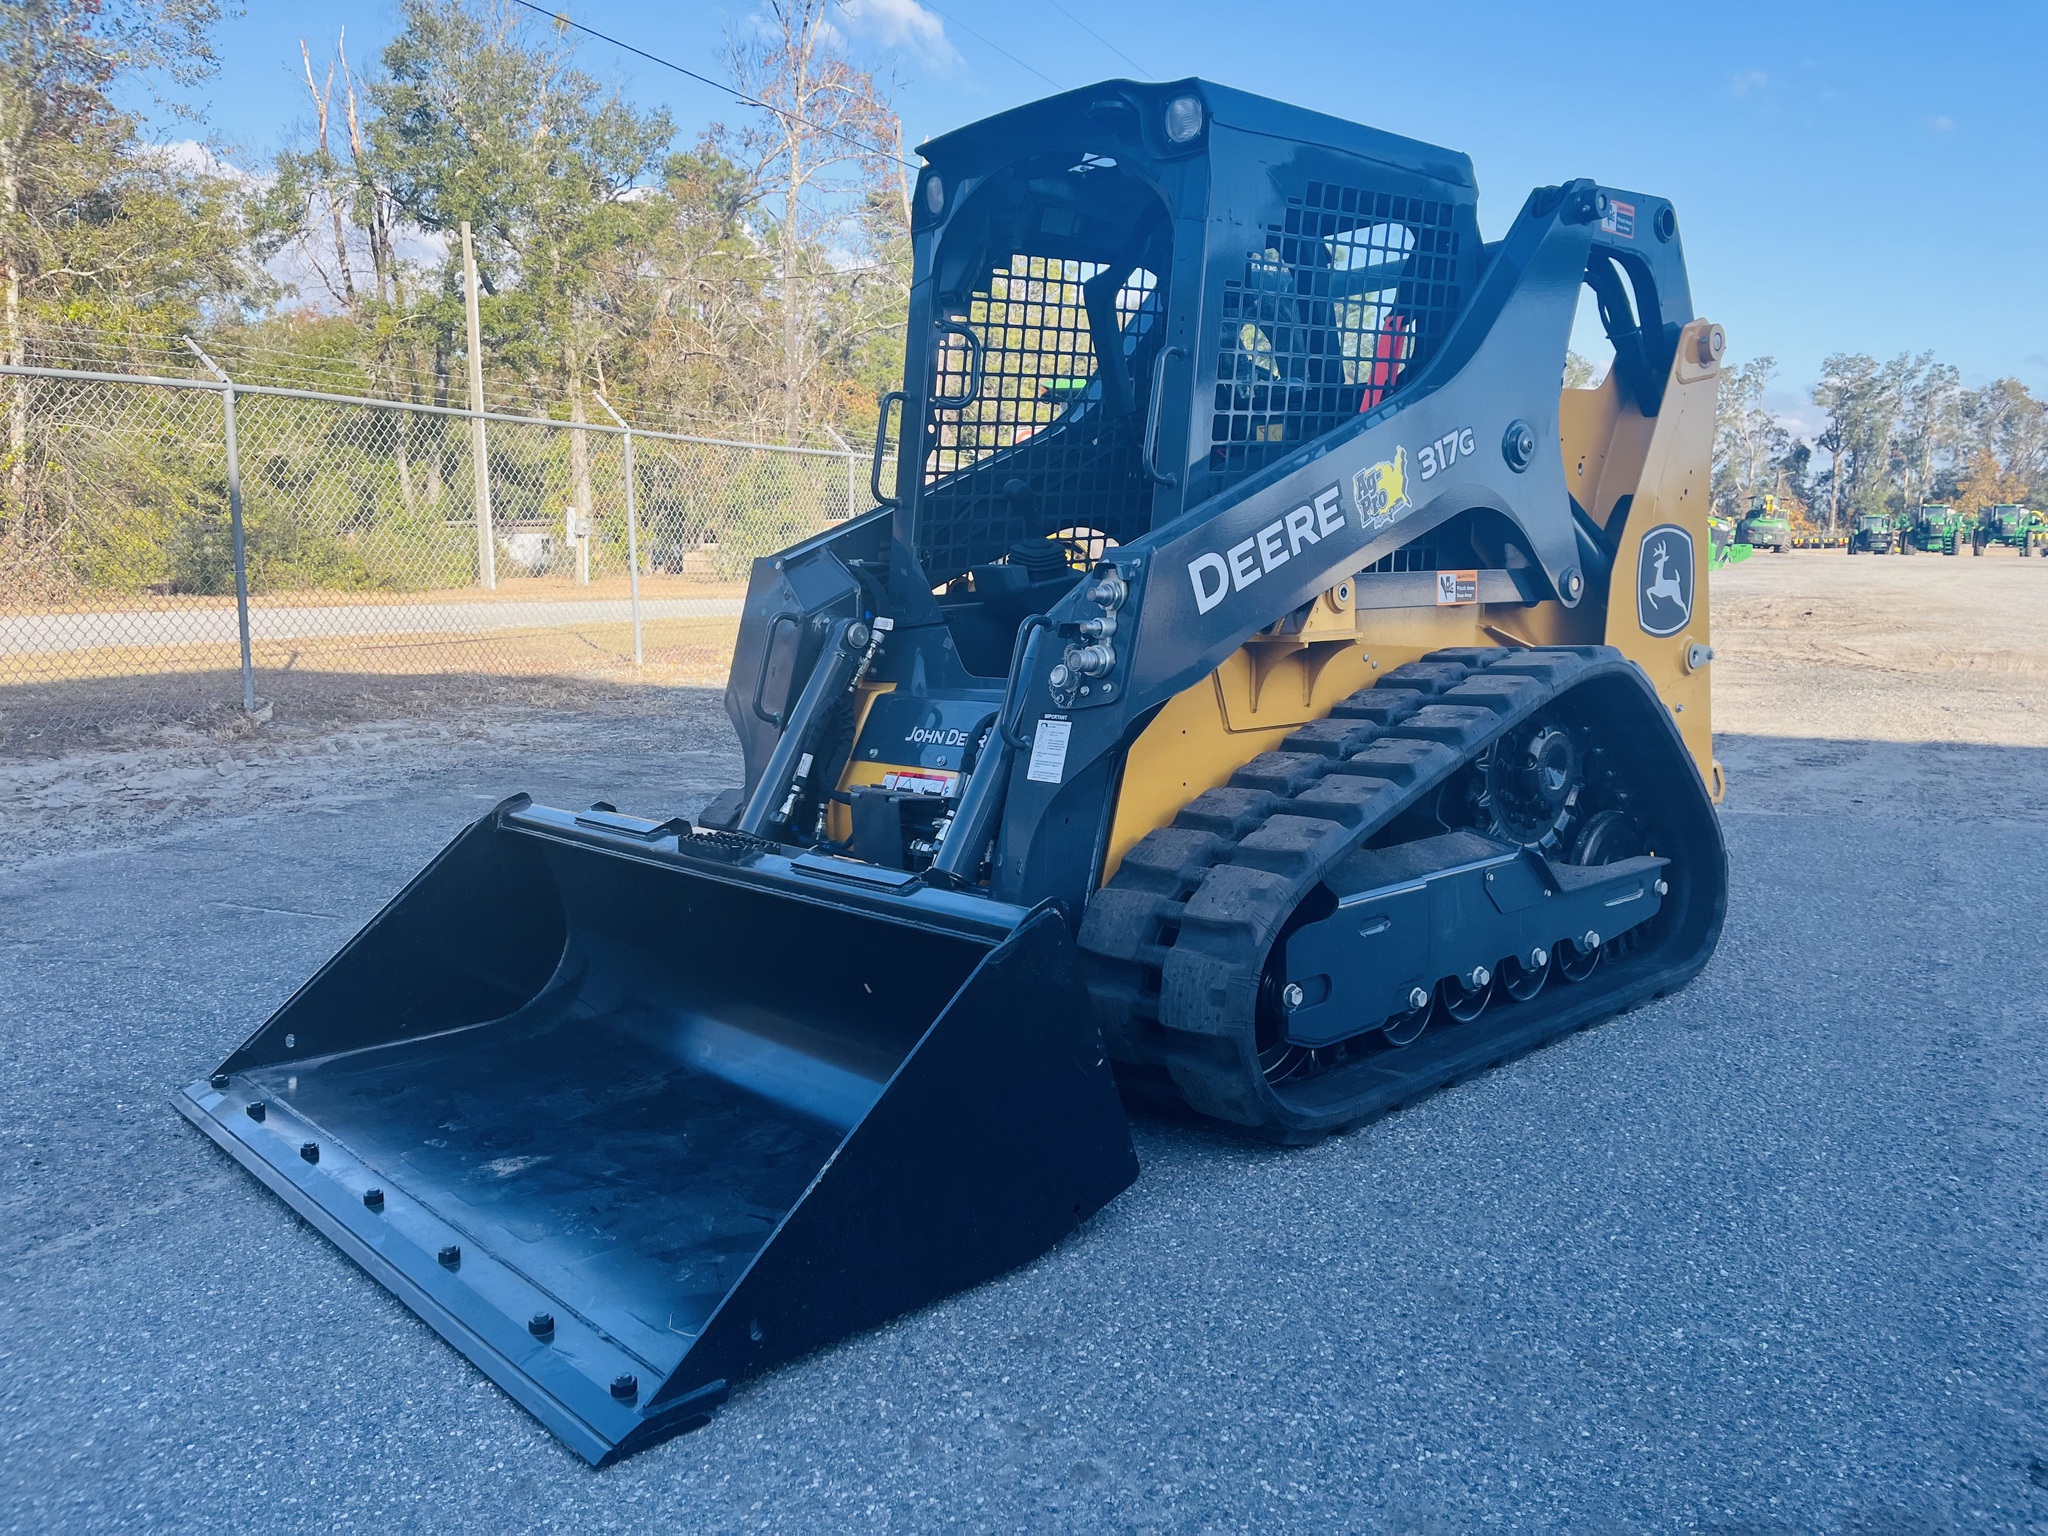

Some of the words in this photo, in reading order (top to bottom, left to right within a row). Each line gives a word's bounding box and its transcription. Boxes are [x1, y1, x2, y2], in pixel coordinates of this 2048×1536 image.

[1418, 427, 1476, 481] 317G
[1359, 489, 1388, 522] Pro
[1188, 484, 1346, 615] DEERE
[904, 726, 946, 745] JOHN
[945, 728, 988, 748] DER
